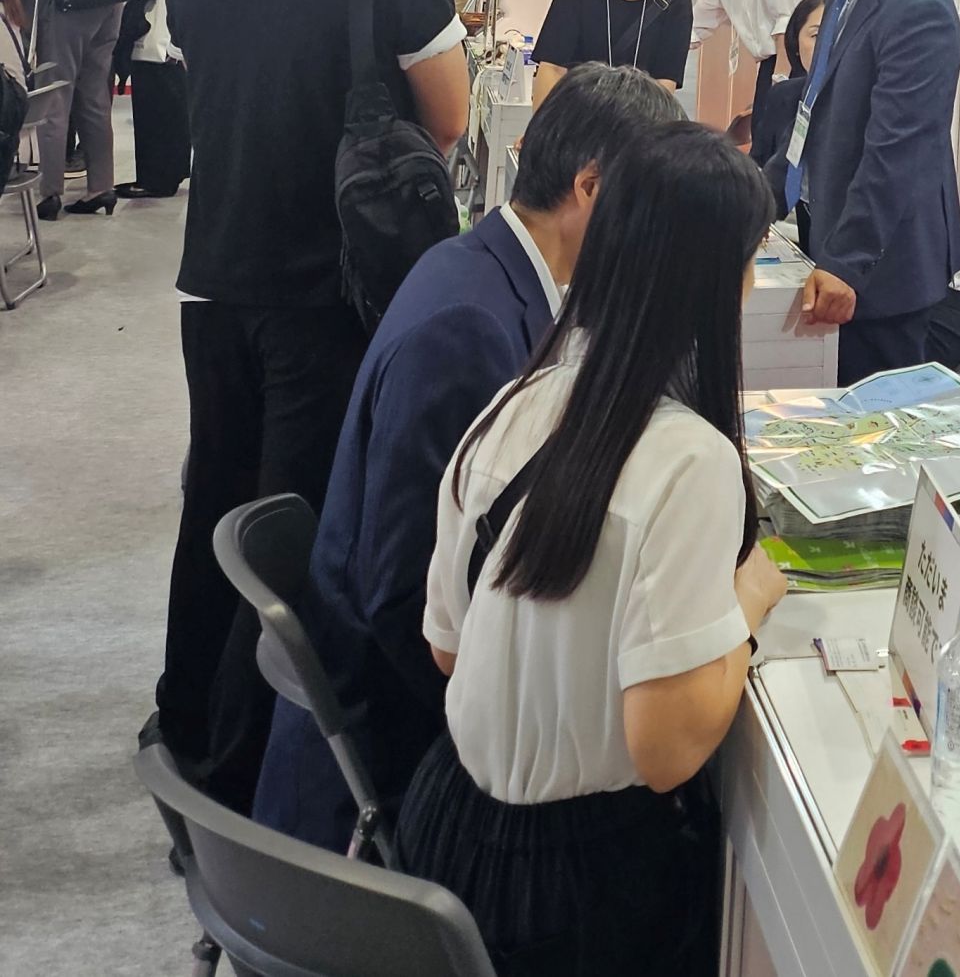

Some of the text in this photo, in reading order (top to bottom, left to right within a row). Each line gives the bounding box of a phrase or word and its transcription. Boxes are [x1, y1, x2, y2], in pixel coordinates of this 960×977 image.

[917, 539, 949, 611] ただいま
[902, 575, 942, 665] 商談可能で
